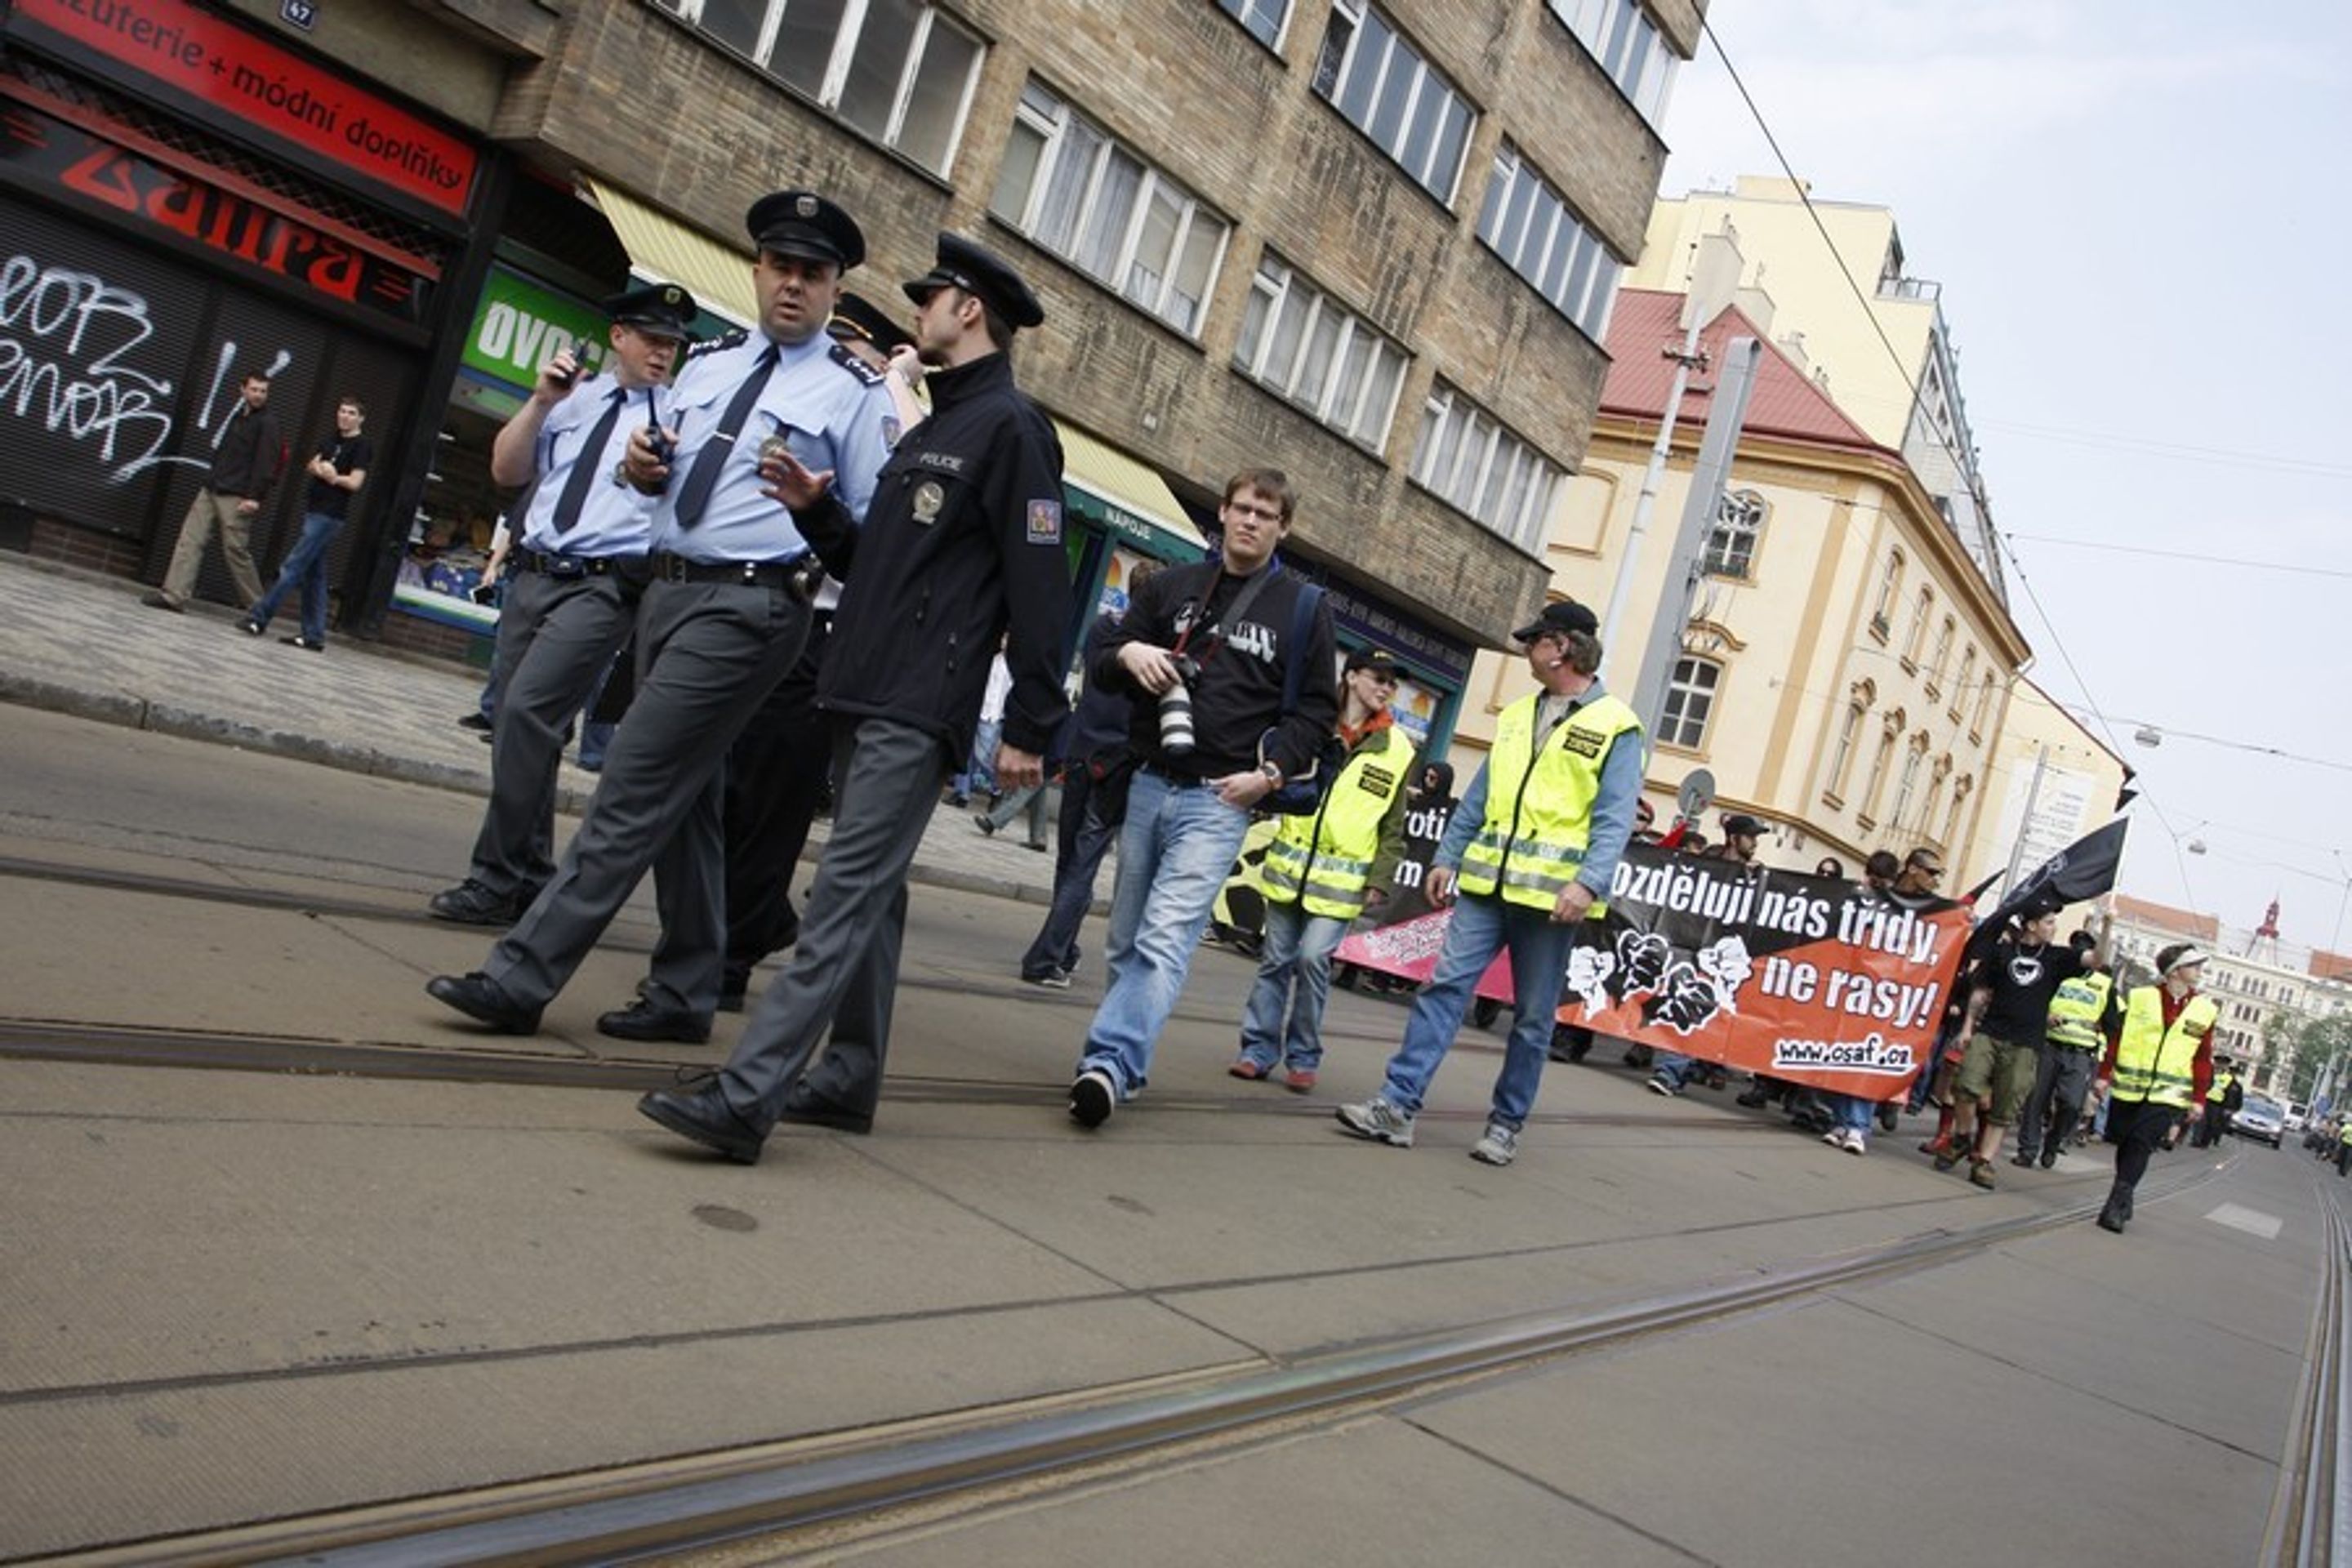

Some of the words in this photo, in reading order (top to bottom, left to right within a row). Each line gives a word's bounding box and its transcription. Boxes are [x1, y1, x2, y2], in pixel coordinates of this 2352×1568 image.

[289, 2, 310, 21] 47
[231, 64, 342, 133] módní
[344, 117, 462, 189] doplňky
[1757, 887, 1831, 938] nás
[1838, 897, 1940, 967] třídy,
[1761, 956, 1819, 1003] ne
[1824, 969, 1940, 1028] rasy!
